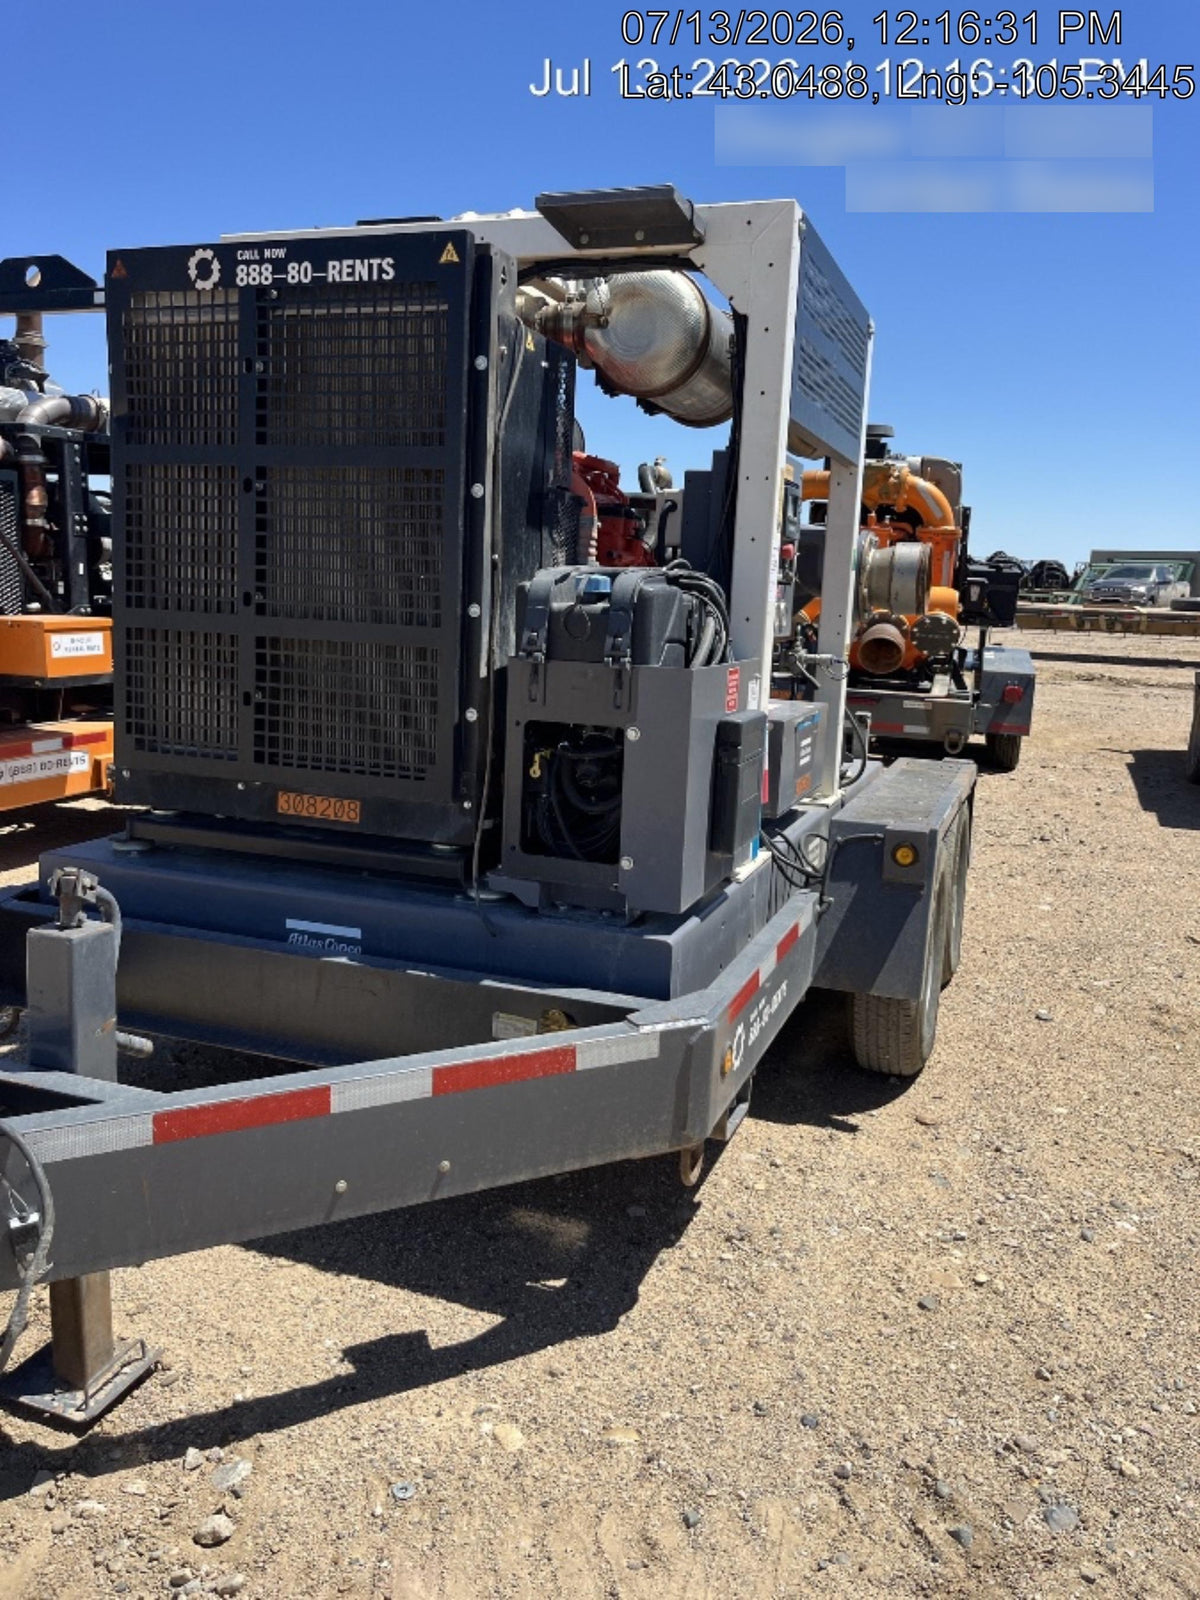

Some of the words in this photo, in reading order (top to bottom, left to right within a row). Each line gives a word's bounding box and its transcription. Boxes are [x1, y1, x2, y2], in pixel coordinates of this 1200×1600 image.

[237, 250, 260, 260] CALL
[264, 248, 287, 259] NOW
[236, 258, 395, 286] 888-80-RENTS
[279, 791, 359, 821] 308208
